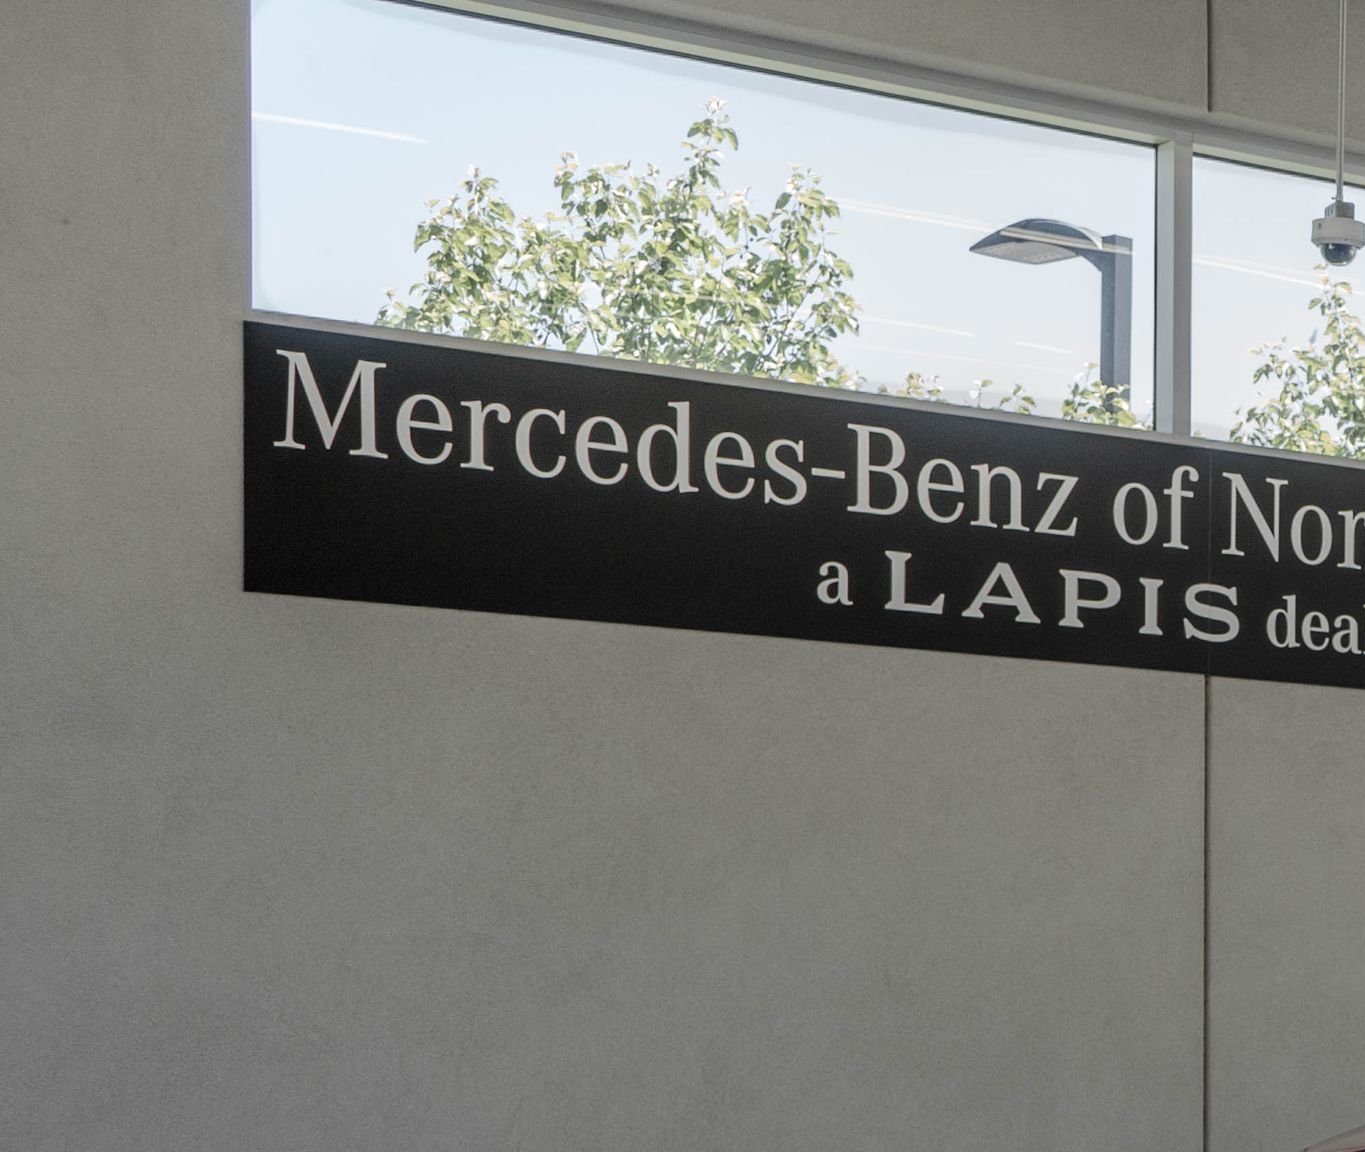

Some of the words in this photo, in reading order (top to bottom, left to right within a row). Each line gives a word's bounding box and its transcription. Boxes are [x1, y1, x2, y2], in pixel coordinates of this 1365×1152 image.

[273, 348, 1080, 537] Mercedes-Benz
[1112, 464, 1200, 551] of
[816, 561, 854, 606] a
[884, 550, 1240, 643] LAPIS
